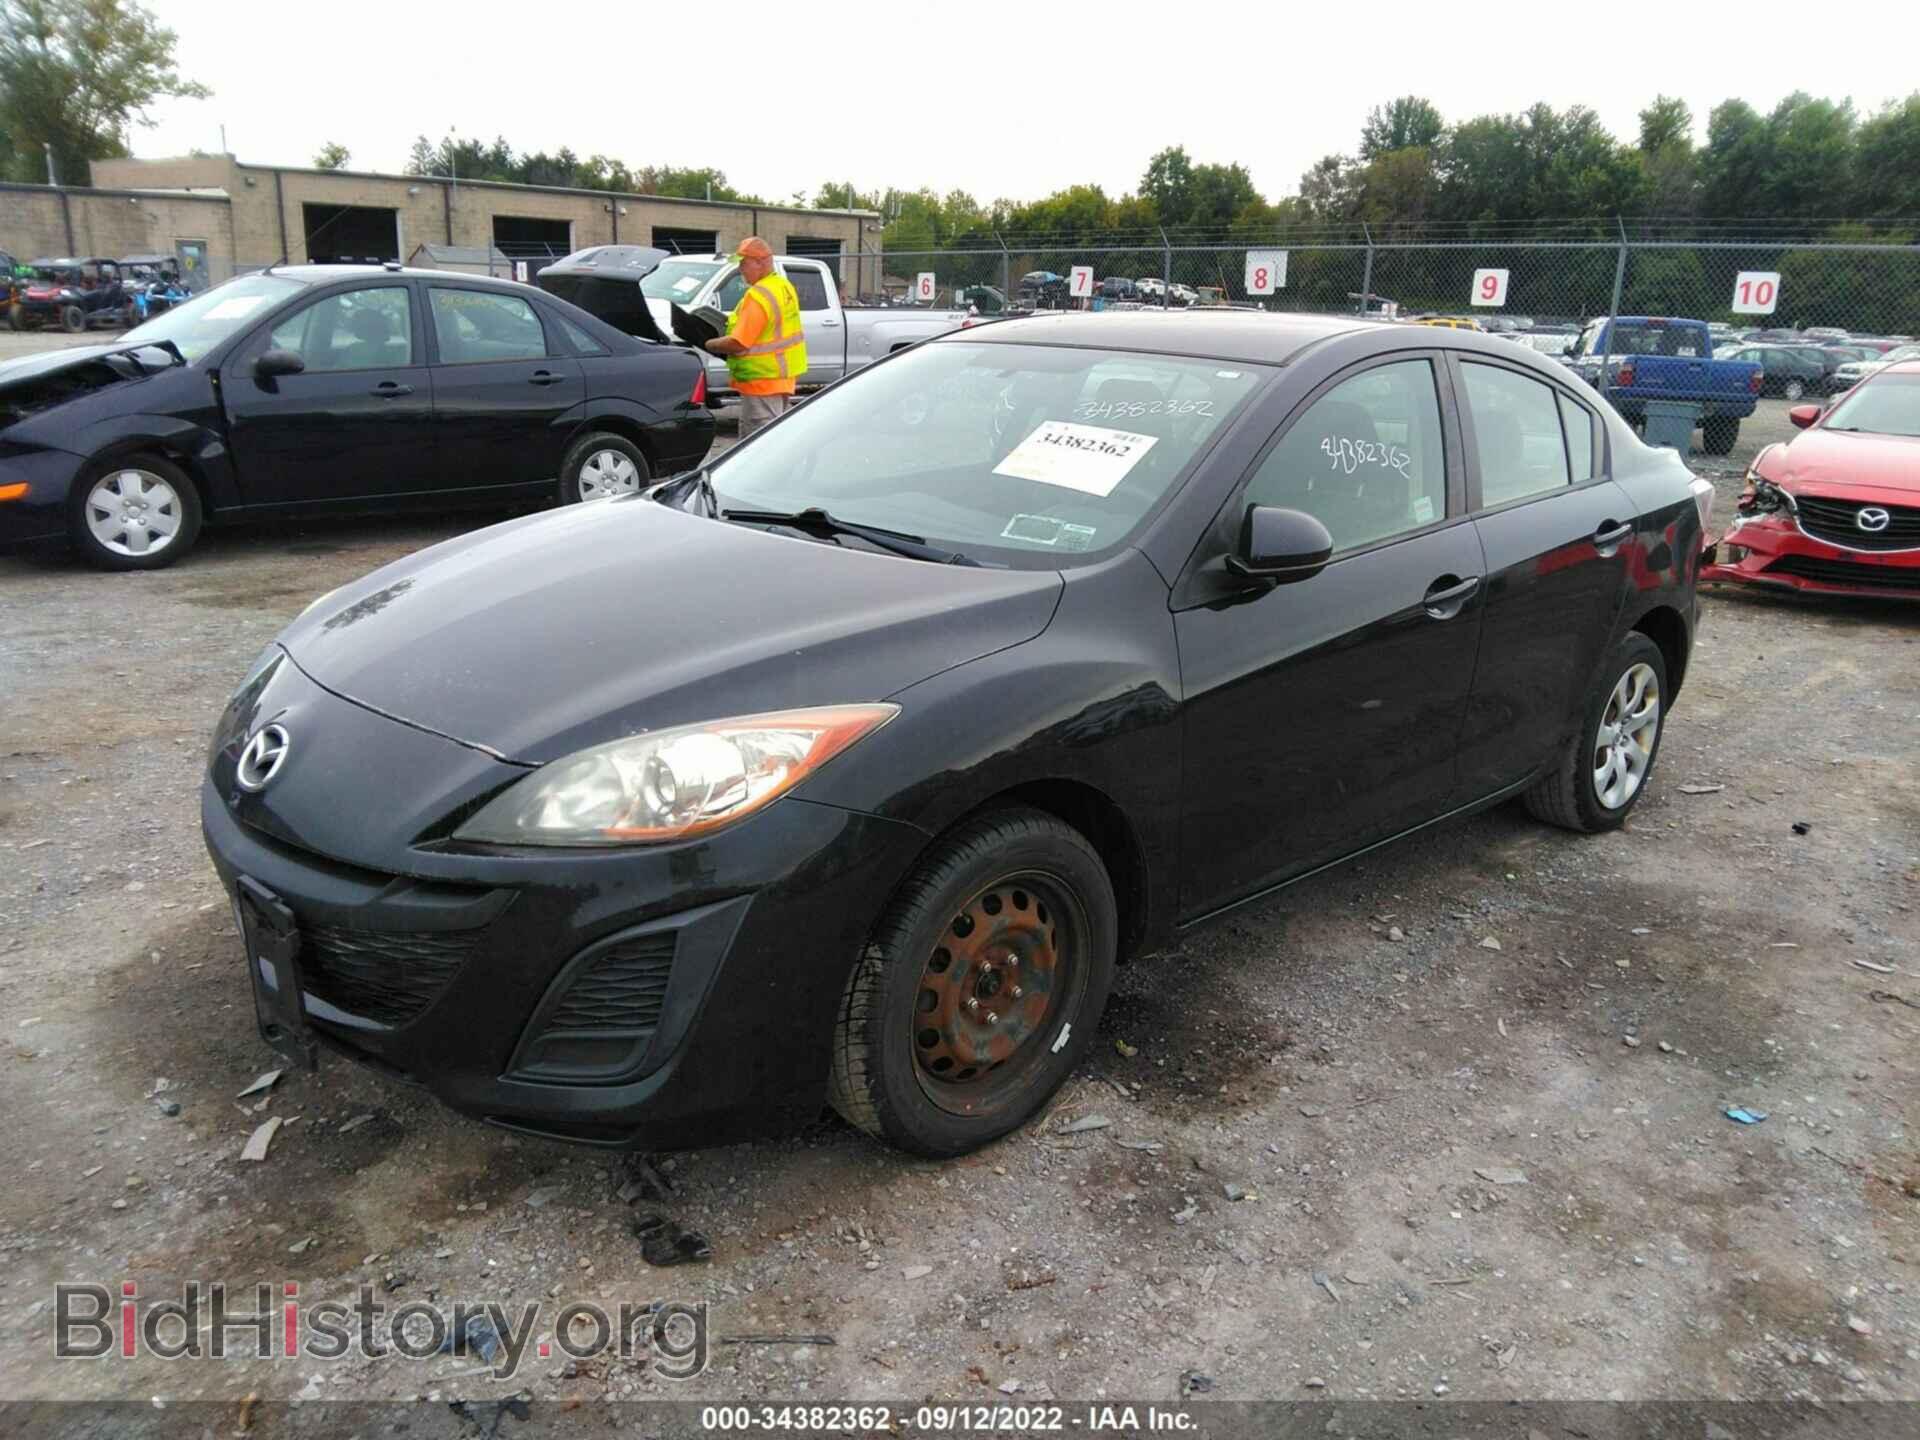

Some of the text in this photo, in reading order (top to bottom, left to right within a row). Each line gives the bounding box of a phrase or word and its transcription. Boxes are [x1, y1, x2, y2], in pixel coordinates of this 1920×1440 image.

[921, 278, 931, 297] 6
[1076, 272, 1088, 293] 7
[1254, 268, 1268, 290] 8
[1480, 276, 1499, 300] 9
[1738, 281, 1774, 306] 10
[1037, 432, 1132, 457] 34382362
